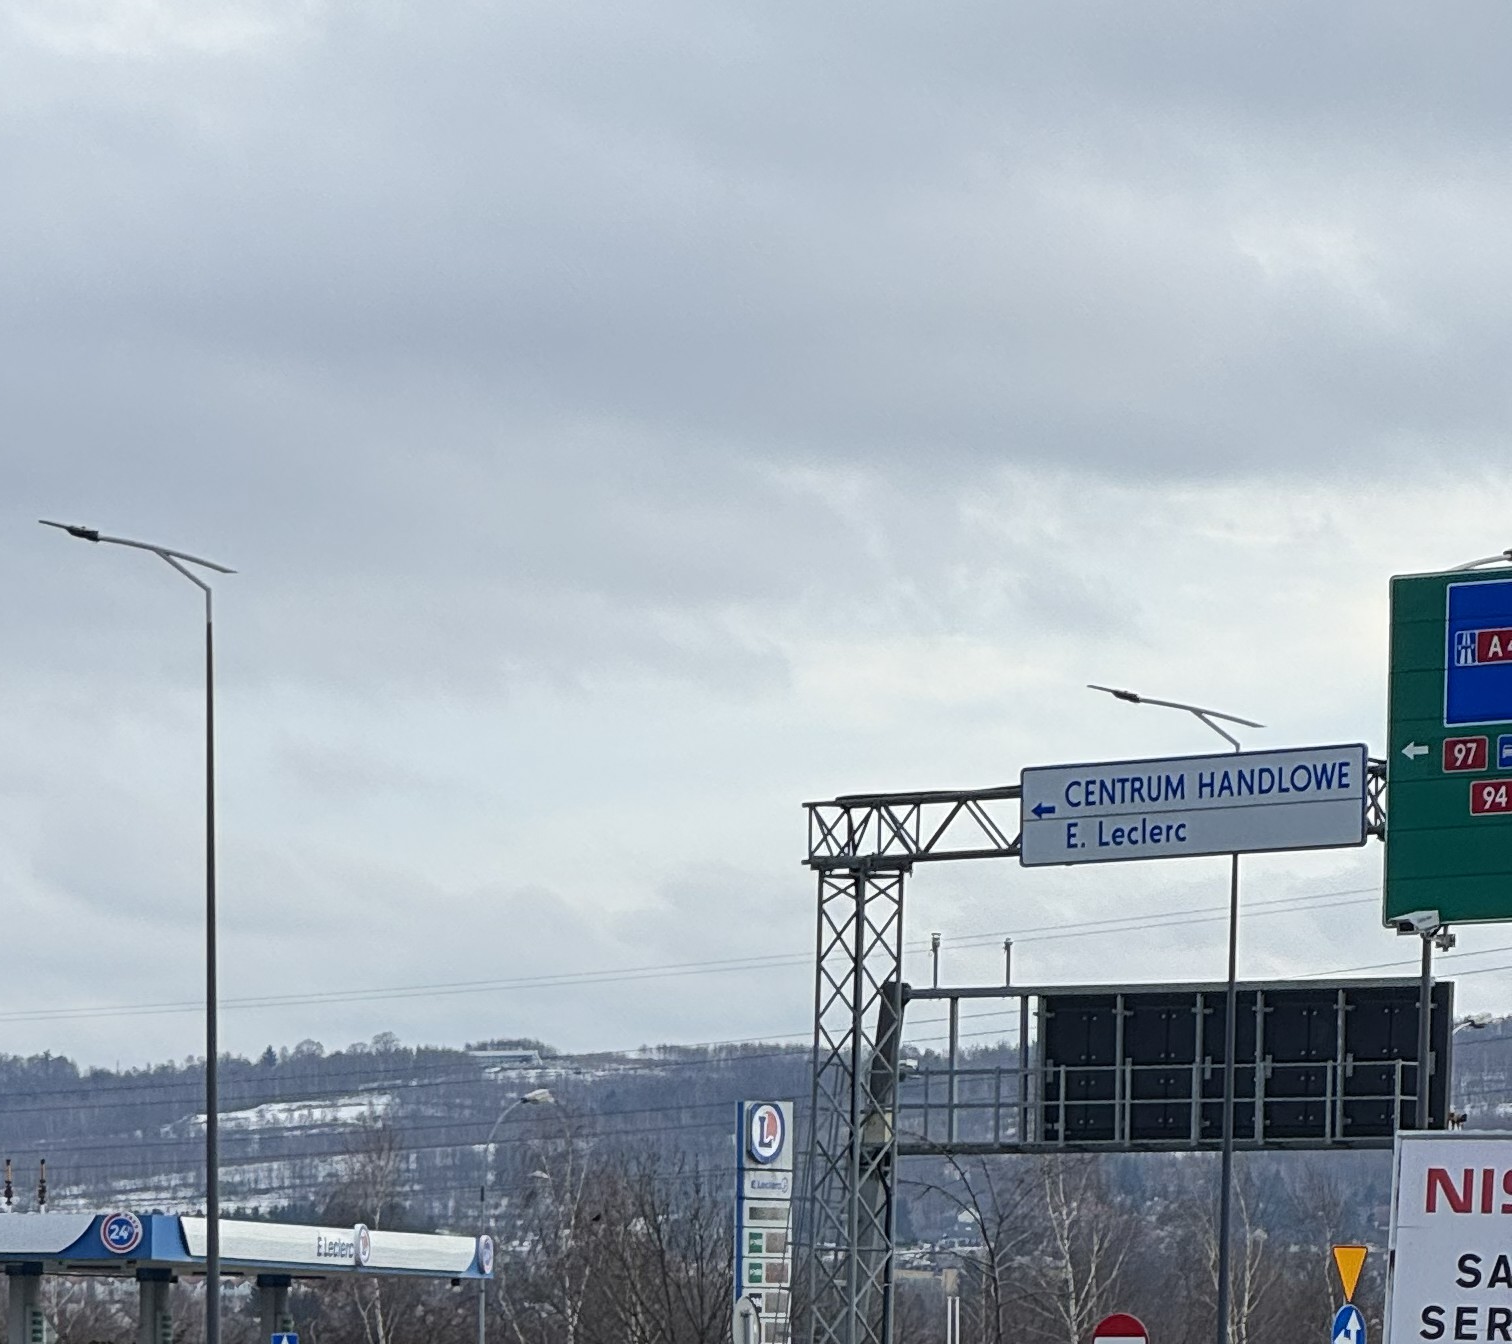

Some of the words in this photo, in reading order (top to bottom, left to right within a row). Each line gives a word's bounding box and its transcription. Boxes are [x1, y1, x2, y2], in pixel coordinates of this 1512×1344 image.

[1453, 743, 1478, 767] 97
[1064, 773, 1186, 807] CENTRUM
[1199, 761, 1352, 799] HANDLOWE
[1482, 785, 1508, 809] 94
[1066, 822, 1087, 849] E.
[1098, 817, 1187, 847] Leclerc
[1419, 1305, 1512, 1341] SER
